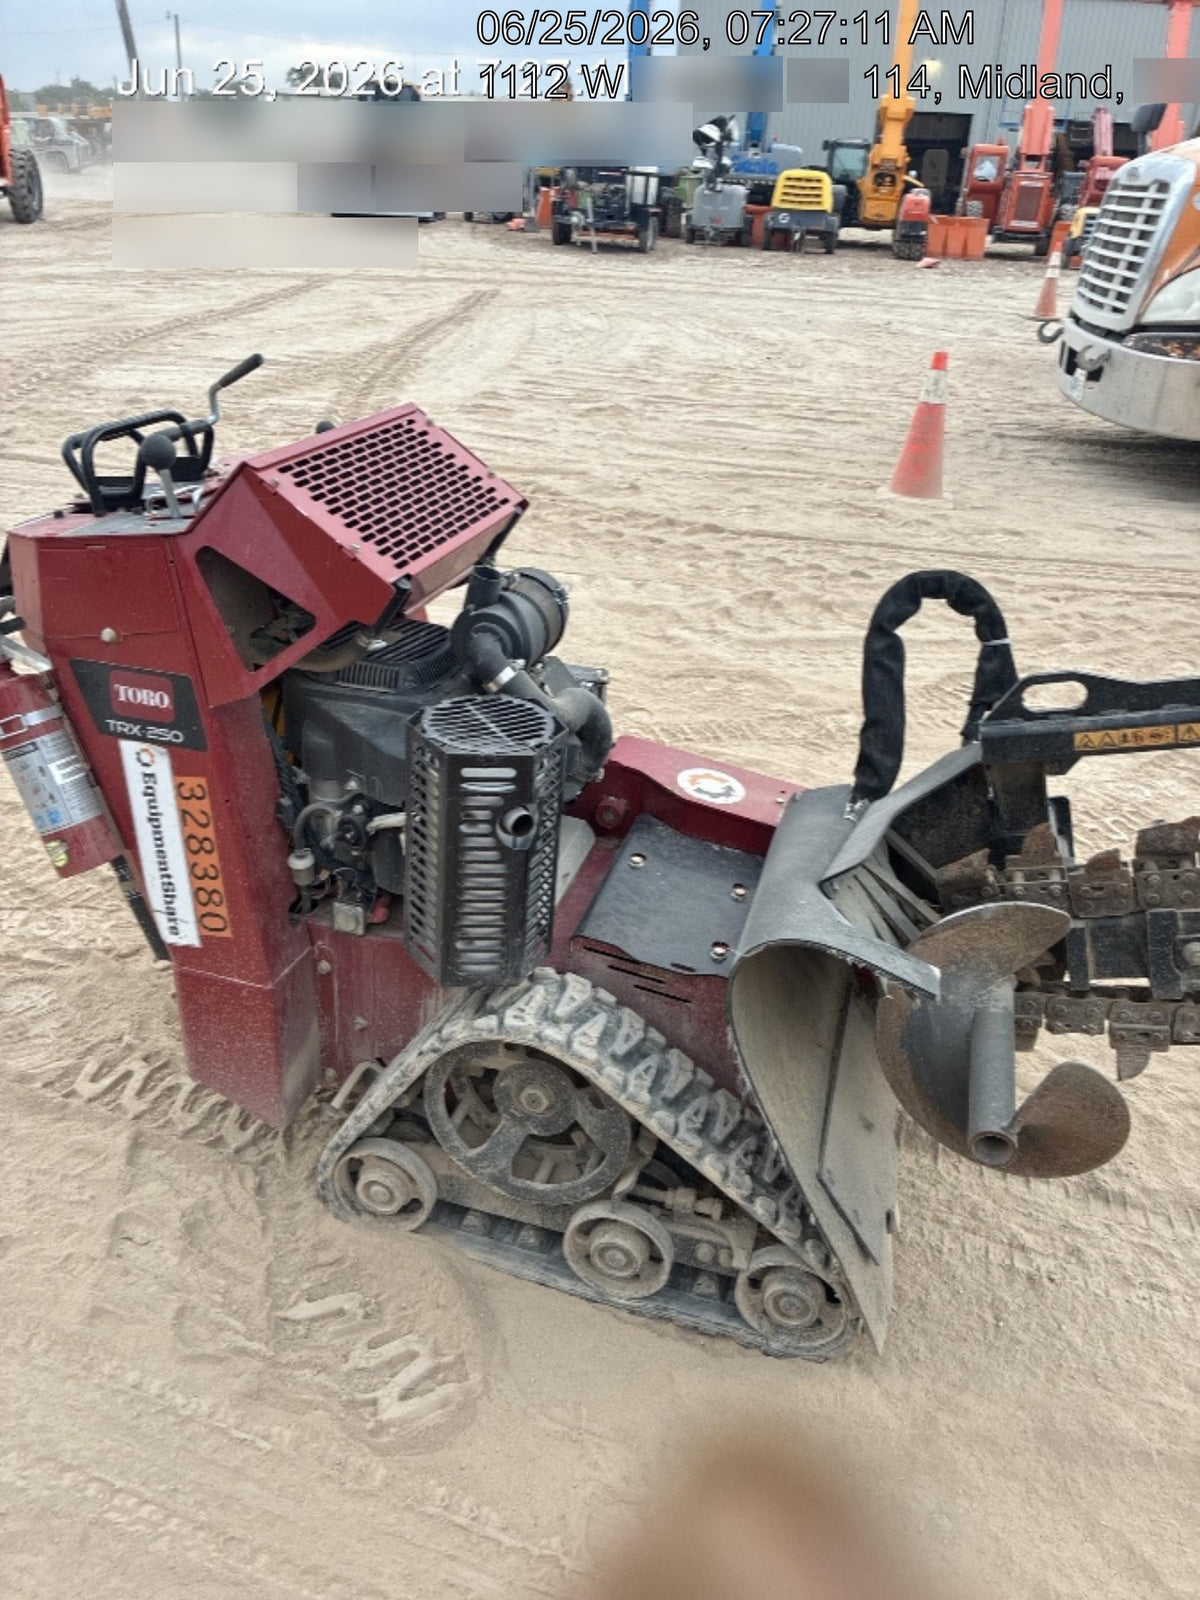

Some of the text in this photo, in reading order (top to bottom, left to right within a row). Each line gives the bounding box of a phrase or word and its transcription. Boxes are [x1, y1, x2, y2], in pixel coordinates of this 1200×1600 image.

[105, 719, 185, 743] TRX-250
[113, 683, 171, 709] TORO
[141, 771, 181, 937] EquipmentShare
[177, 781, 229, 933] 328380
